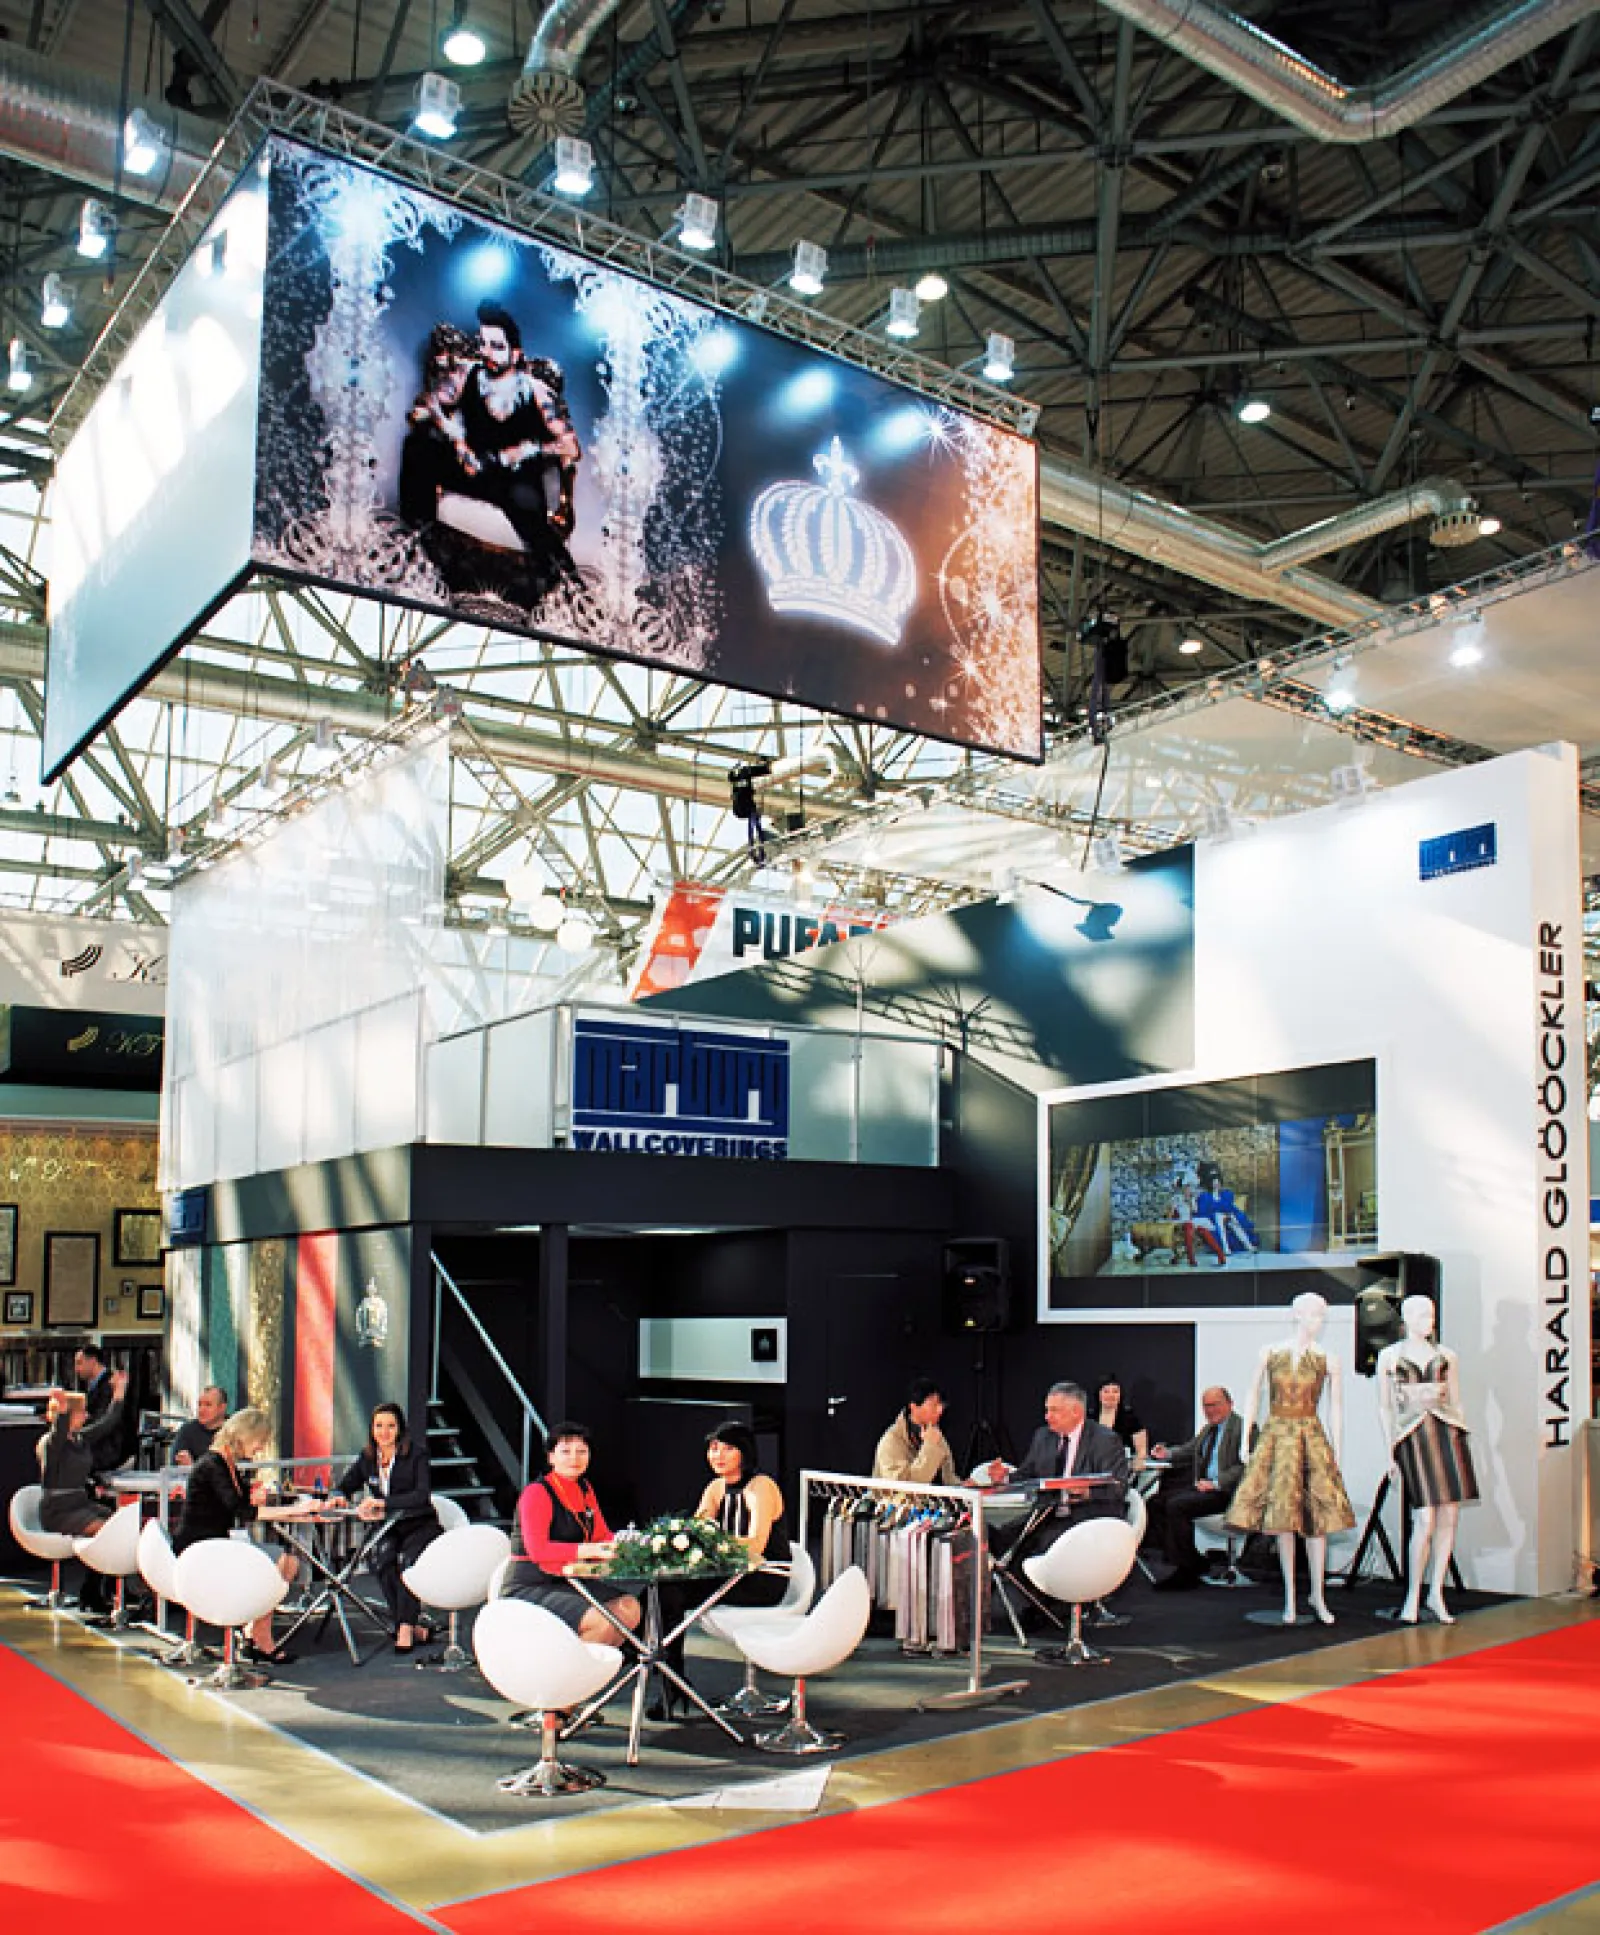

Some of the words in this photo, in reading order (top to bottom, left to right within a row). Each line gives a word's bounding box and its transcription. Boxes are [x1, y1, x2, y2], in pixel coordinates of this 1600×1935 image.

[572, 1129, 788, 1160] WALLCOVERINGS
[1537, 920, 1568, 1229] GLÖÖCKLER
[1545, 1246, 1570, 1448] HARALD
